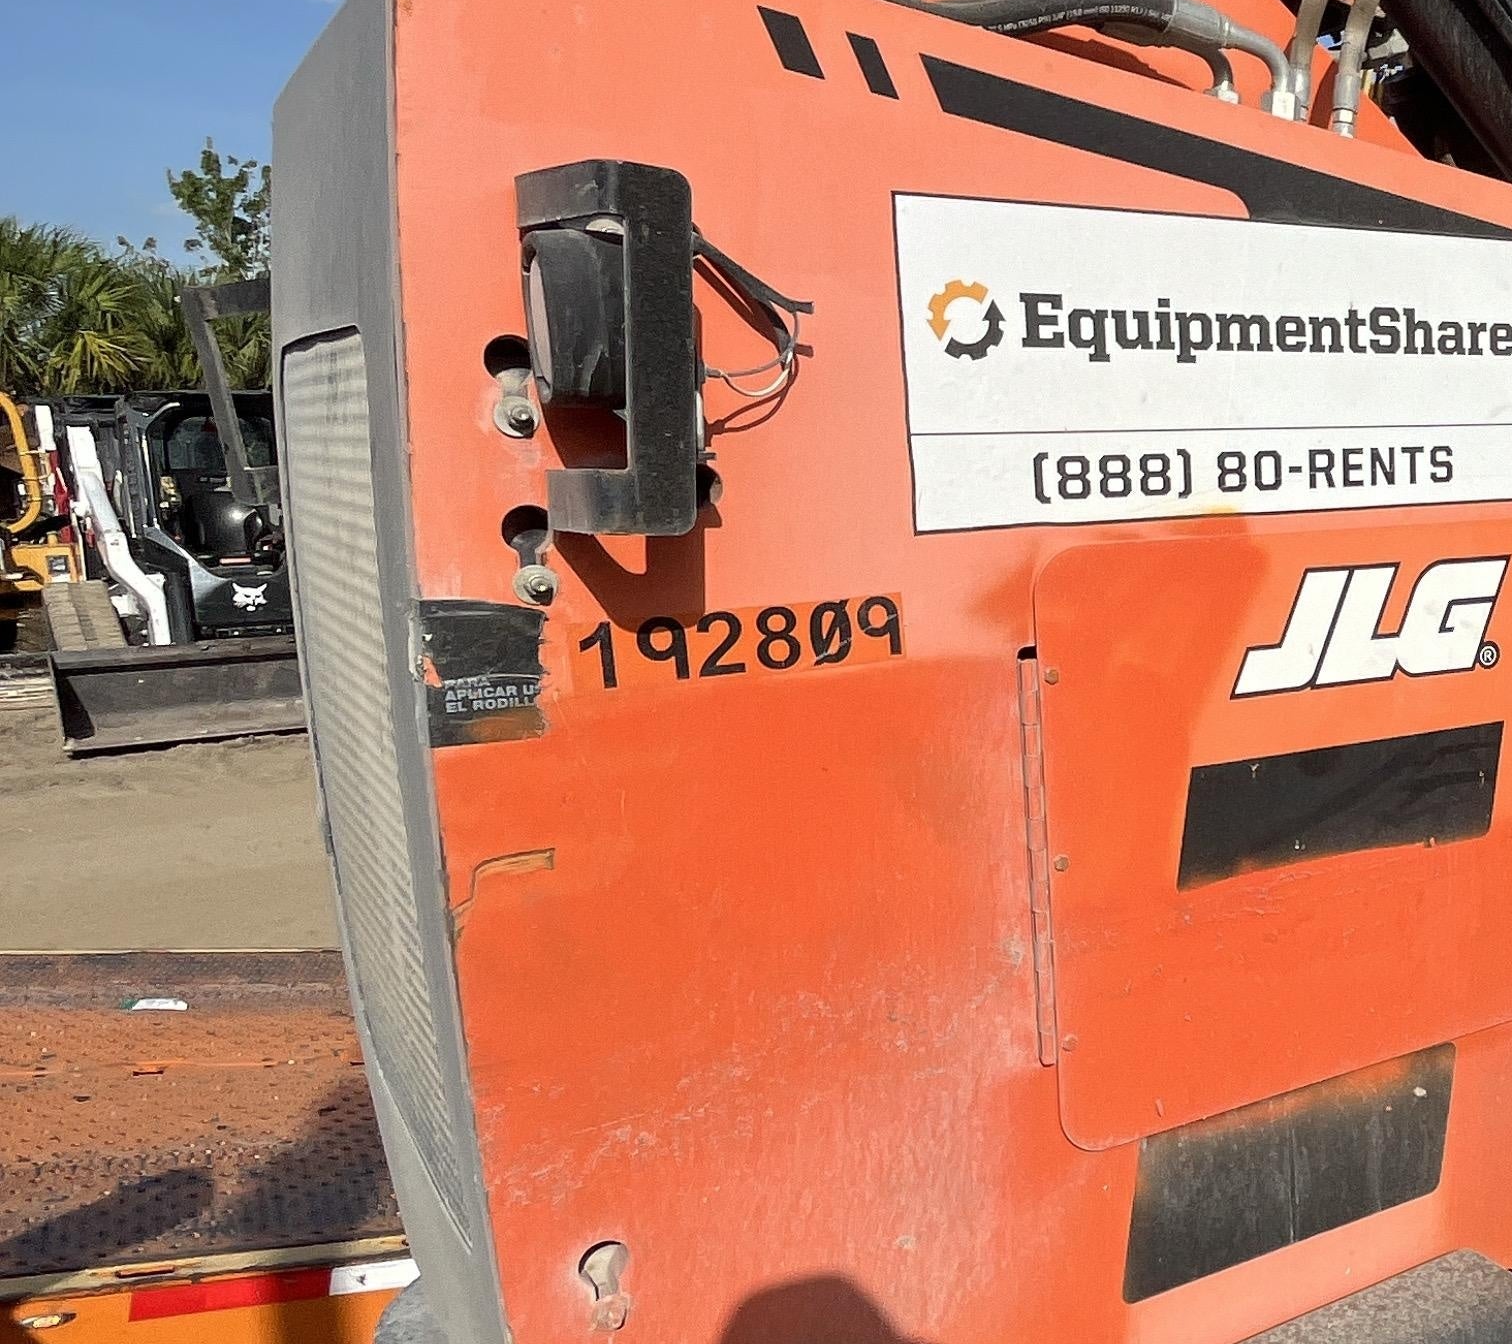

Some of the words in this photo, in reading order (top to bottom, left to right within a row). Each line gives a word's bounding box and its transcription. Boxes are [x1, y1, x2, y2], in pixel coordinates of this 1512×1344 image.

[1032, 448, 1193, 504] (888)
[1216, 444, 1454, 493] 80-RENTS
[577, 595, 904, 690] 192809
[445, 700, 468, 714] EL
